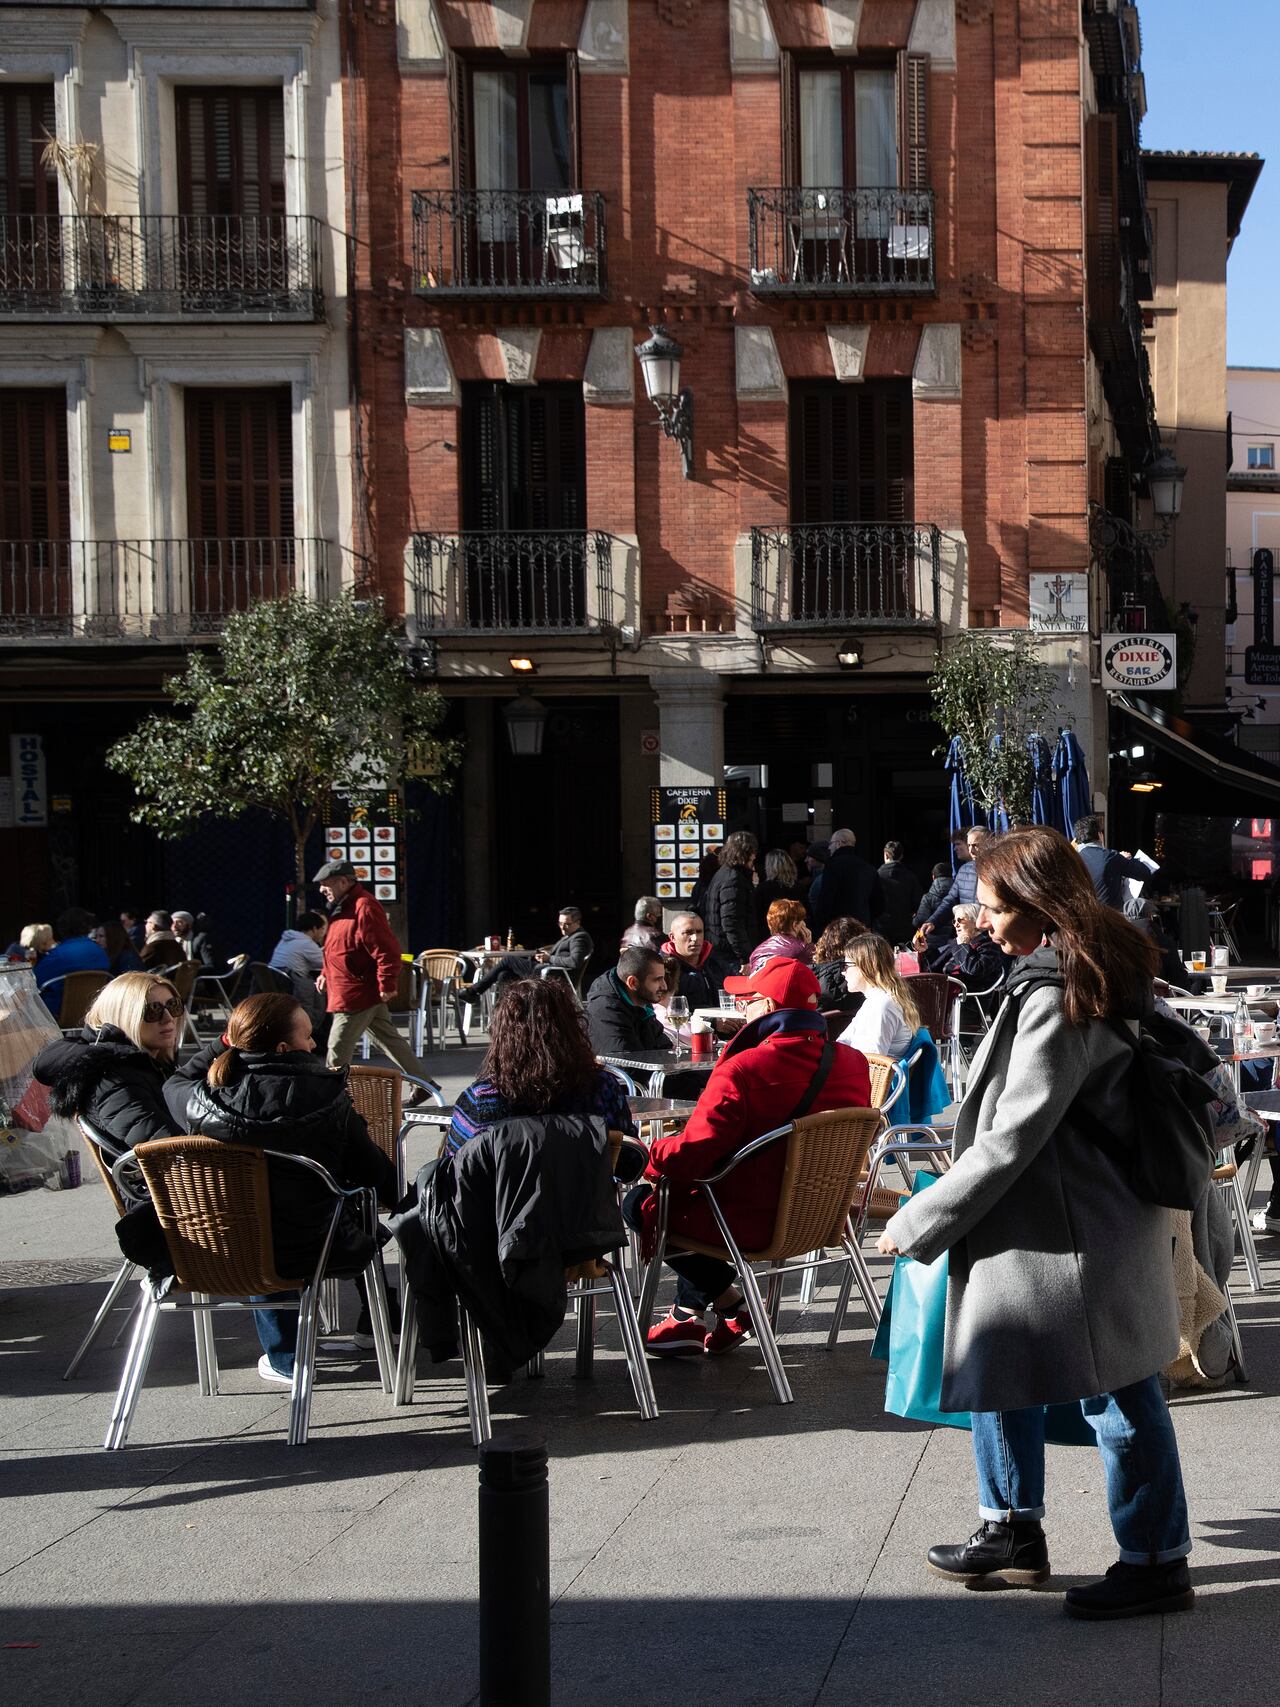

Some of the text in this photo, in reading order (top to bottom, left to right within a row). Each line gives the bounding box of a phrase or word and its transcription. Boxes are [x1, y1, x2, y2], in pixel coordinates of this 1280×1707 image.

[1033, 622, 1086, 631] SANTA CRUZ
[1111, 637, 1165, 654] CAFETERIA
[1119, 651, 1160, 662] DIXIE
[1126, 666, 1151, 675] BAR
[1108, 668, 1169, 686] RESTAURANTE
[1250, 673, 1263, 682] de
[19, 737, 40, 814] HOSTAL
[666, 788, 712, 797] CAFETERIA
[677, 797, 699, 805] DIXIE
